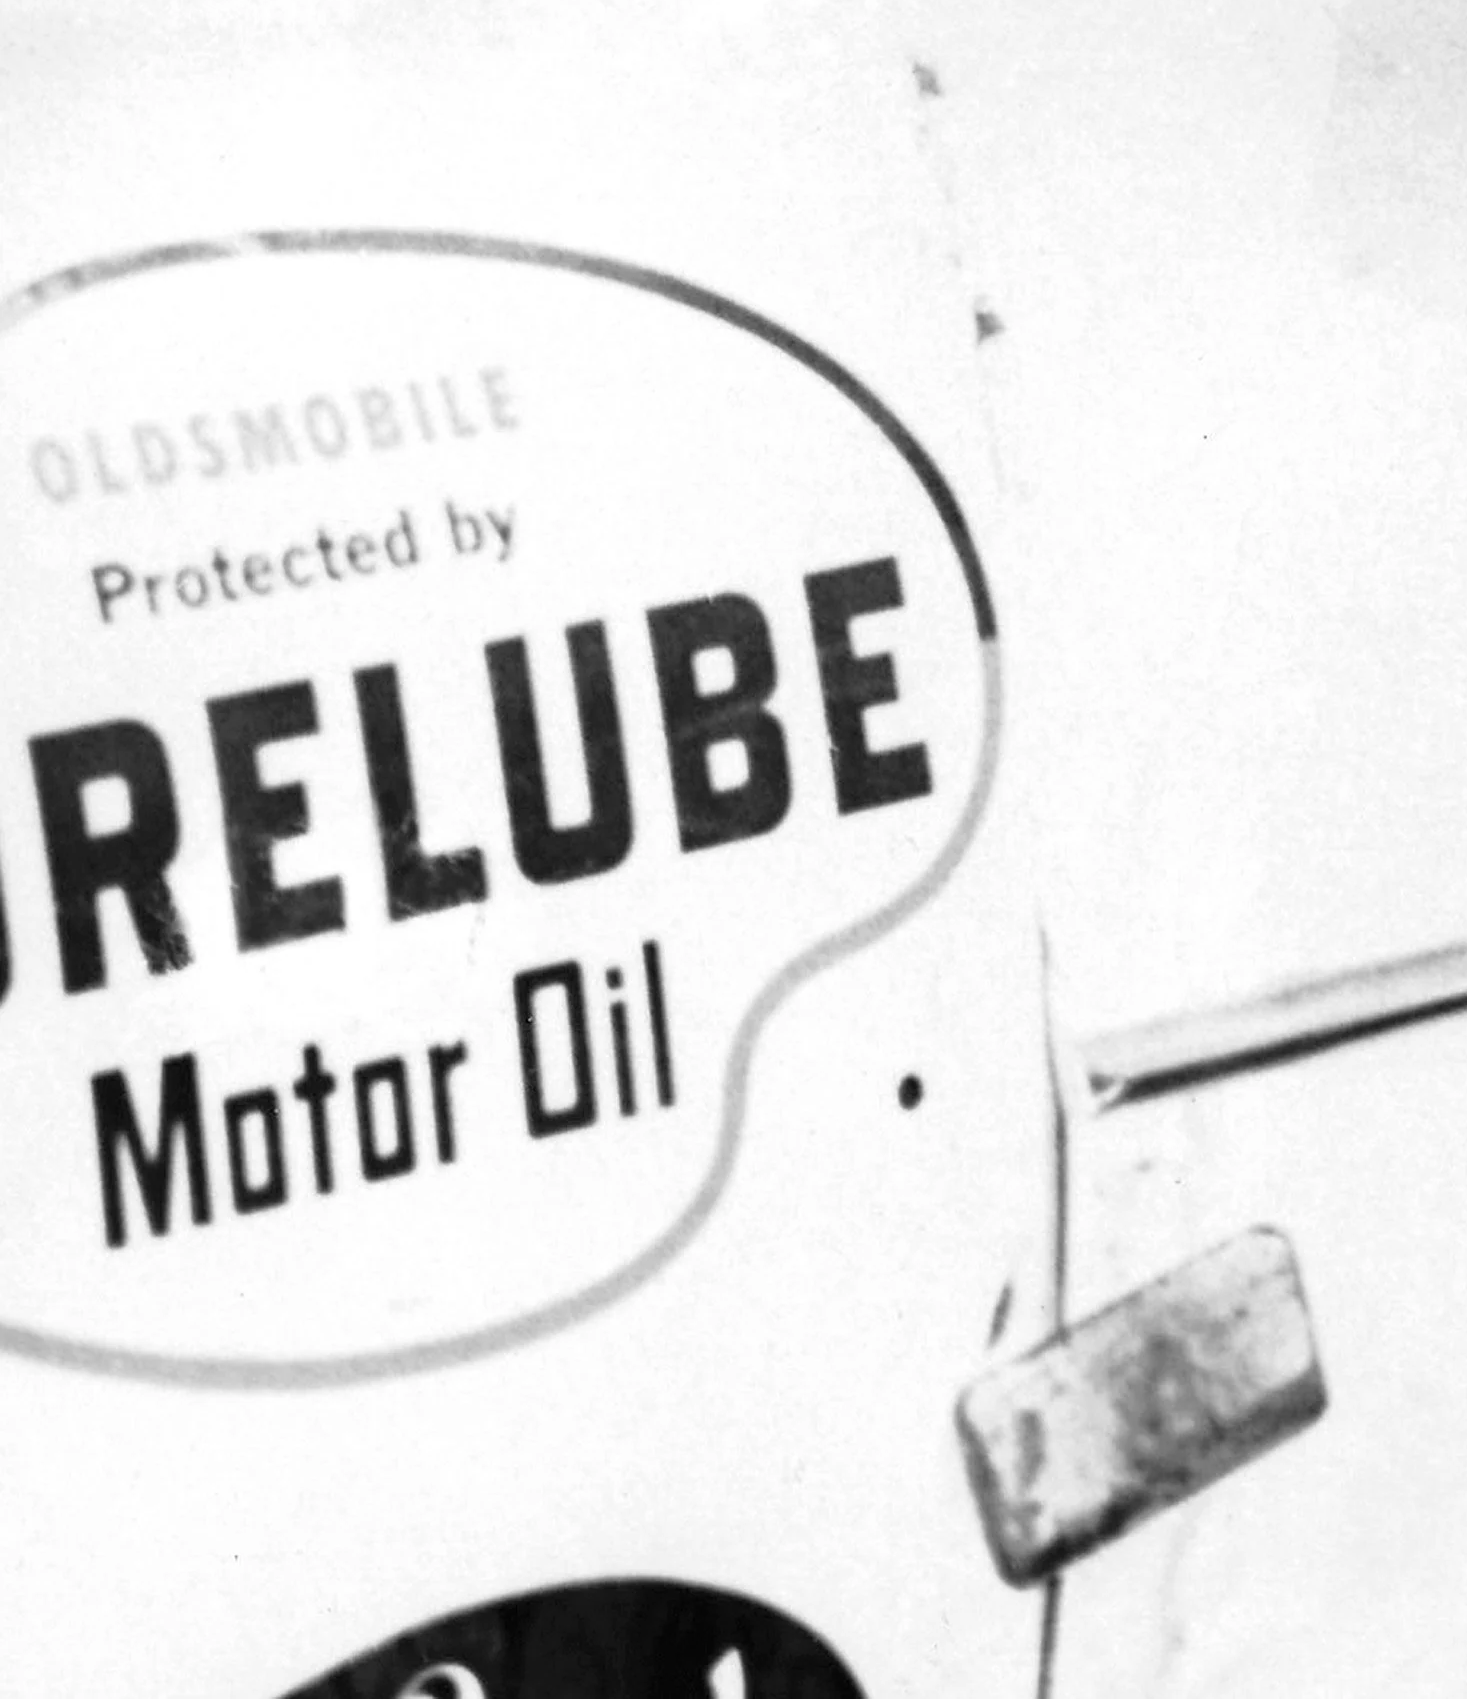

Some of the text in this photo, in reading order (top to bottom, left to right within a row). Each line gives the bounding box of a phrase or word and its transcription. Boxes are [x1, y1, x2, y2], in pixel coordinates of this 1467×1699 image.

[30, 367, 522, 505] OLDSMOBILE
[90, 503, 519, 625] Protected by
[0, 556, 934, 1007] RELUBE
[90, 939, 676, 1249] Motor Oil
